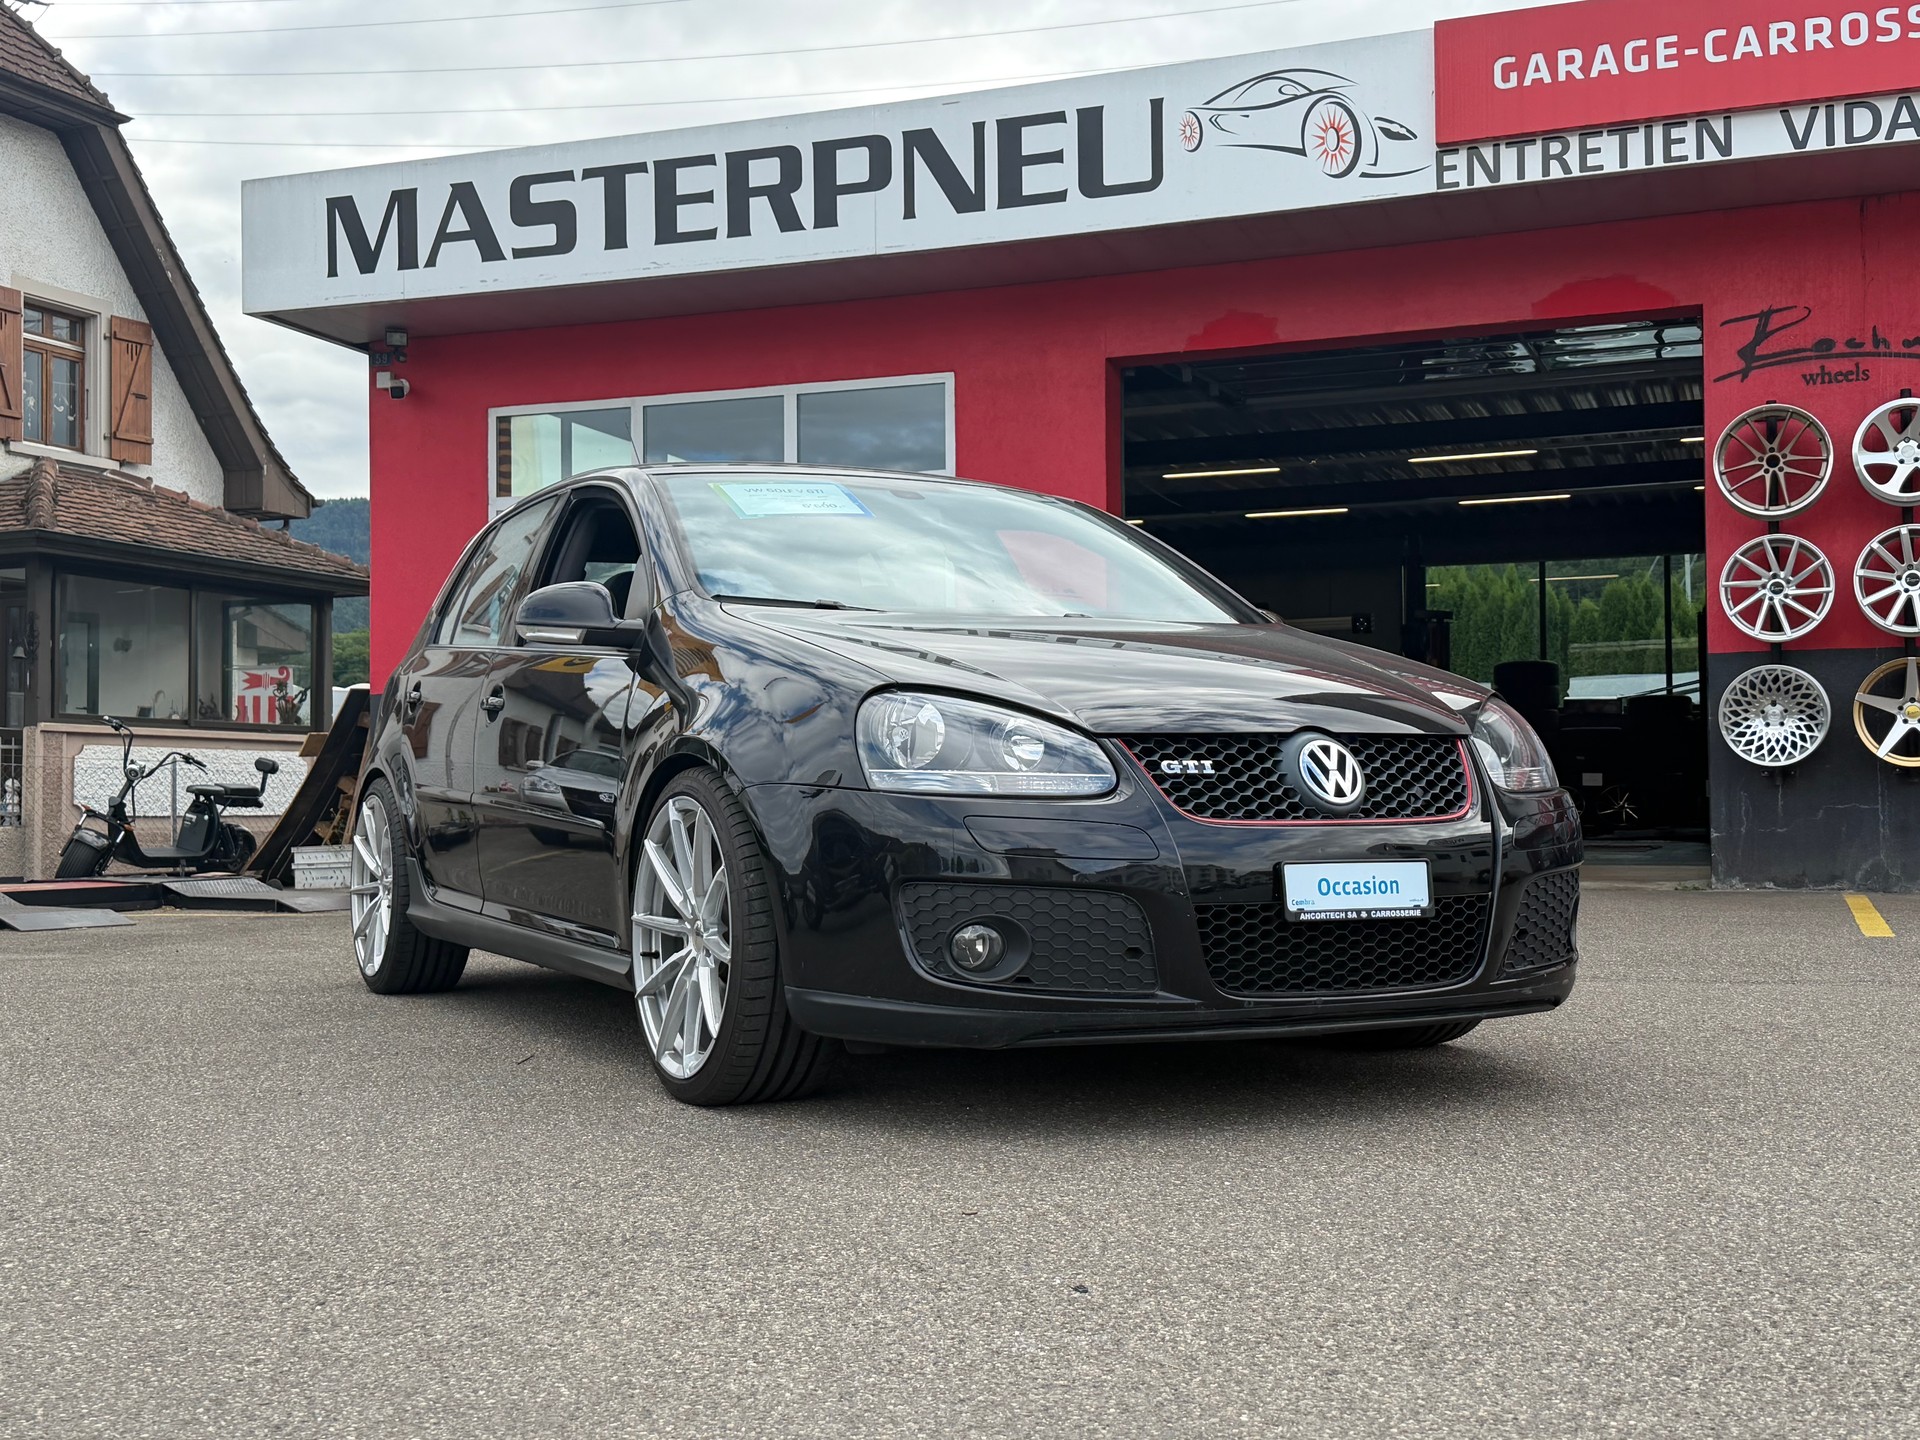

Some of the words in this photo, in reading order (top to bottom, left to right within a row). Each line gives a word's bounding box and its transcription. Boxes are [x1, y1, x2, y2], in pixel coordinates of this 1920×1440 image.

[1436, 115, 1732, 190] ENTRETIEN
[1779, 95, 1920, 151] VIDA
[325, 97, 1164, 278] MASTERPNEU
[1801, 362, 1871, 386] wheels
[1160, 759, 1215, 774] GTI
[1317, 875, 1400, 896] Occasion
[1370, 909, 1421, 918] CARROSSERIE
